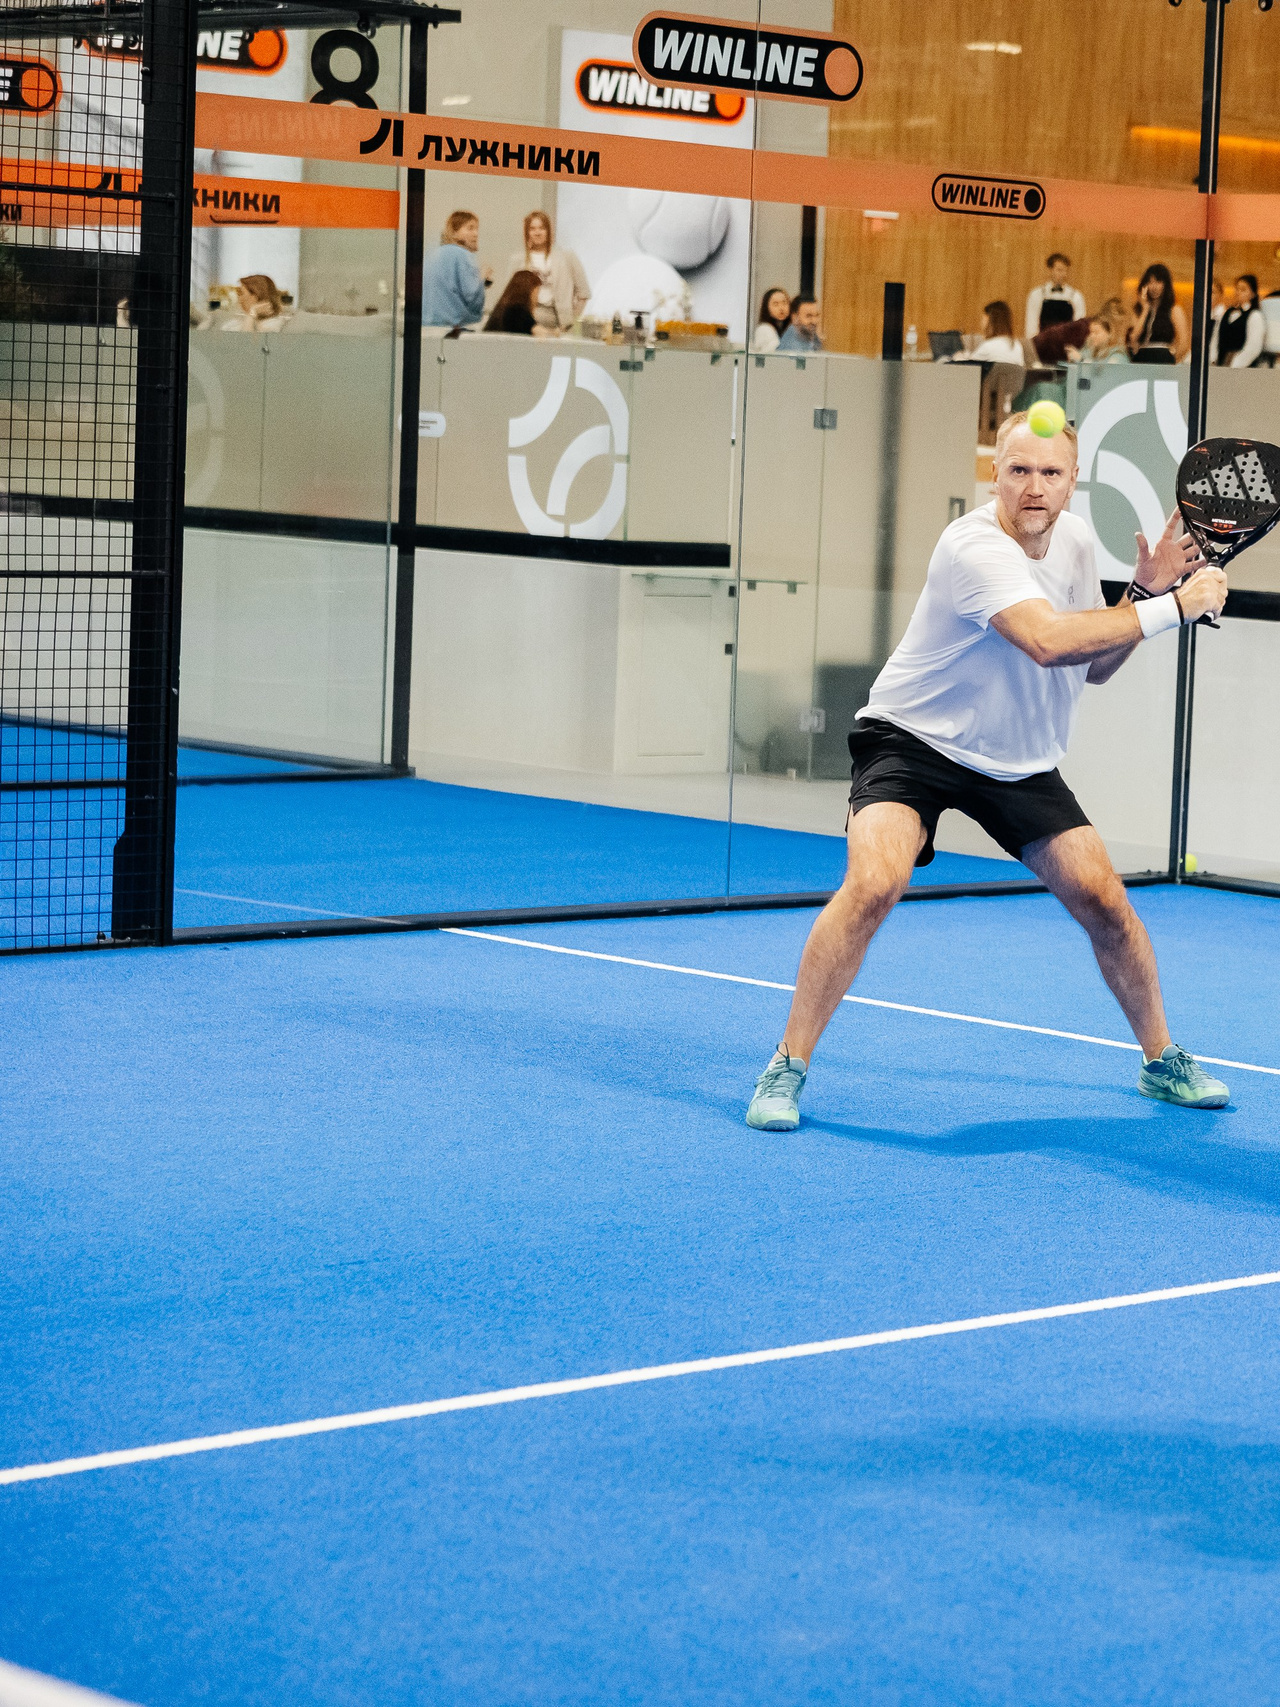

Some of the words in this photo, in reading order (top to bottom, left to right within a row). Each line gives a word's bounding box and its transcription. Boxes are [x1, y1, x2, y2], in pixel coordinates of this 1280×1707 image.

[653, 27, 819, 87] WINLINE
[588, 66, 711, 113] WINLINE
[417, 134, 600, 176] ЛУЖНИКИ
[941, 182, 1021, 209] WINLINE
